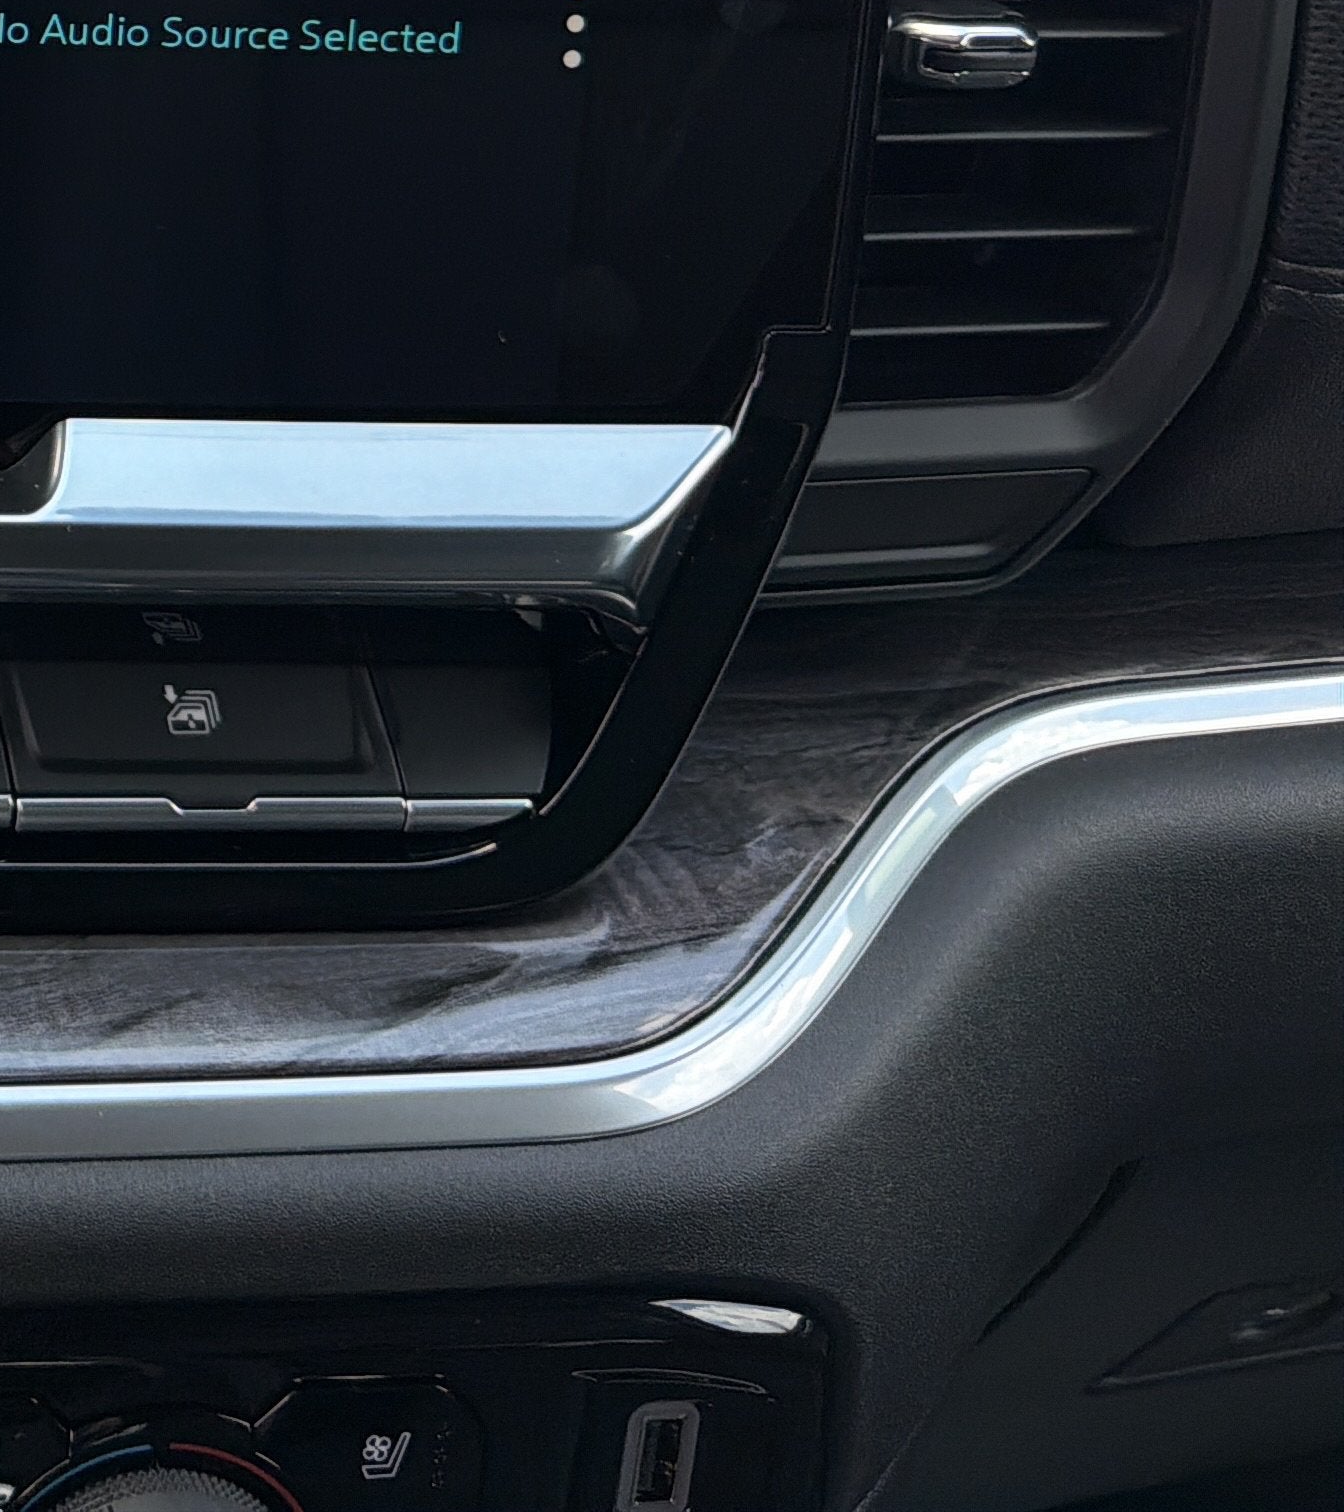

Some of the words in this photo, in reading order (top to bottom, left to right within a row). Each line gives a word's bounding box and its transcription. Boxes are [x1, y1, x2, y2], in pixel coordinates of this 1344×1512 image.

[39, 13, 149, 47] Audio
[161, 16, 289, 51] Source
[299, 18, 461, 54] Selected
